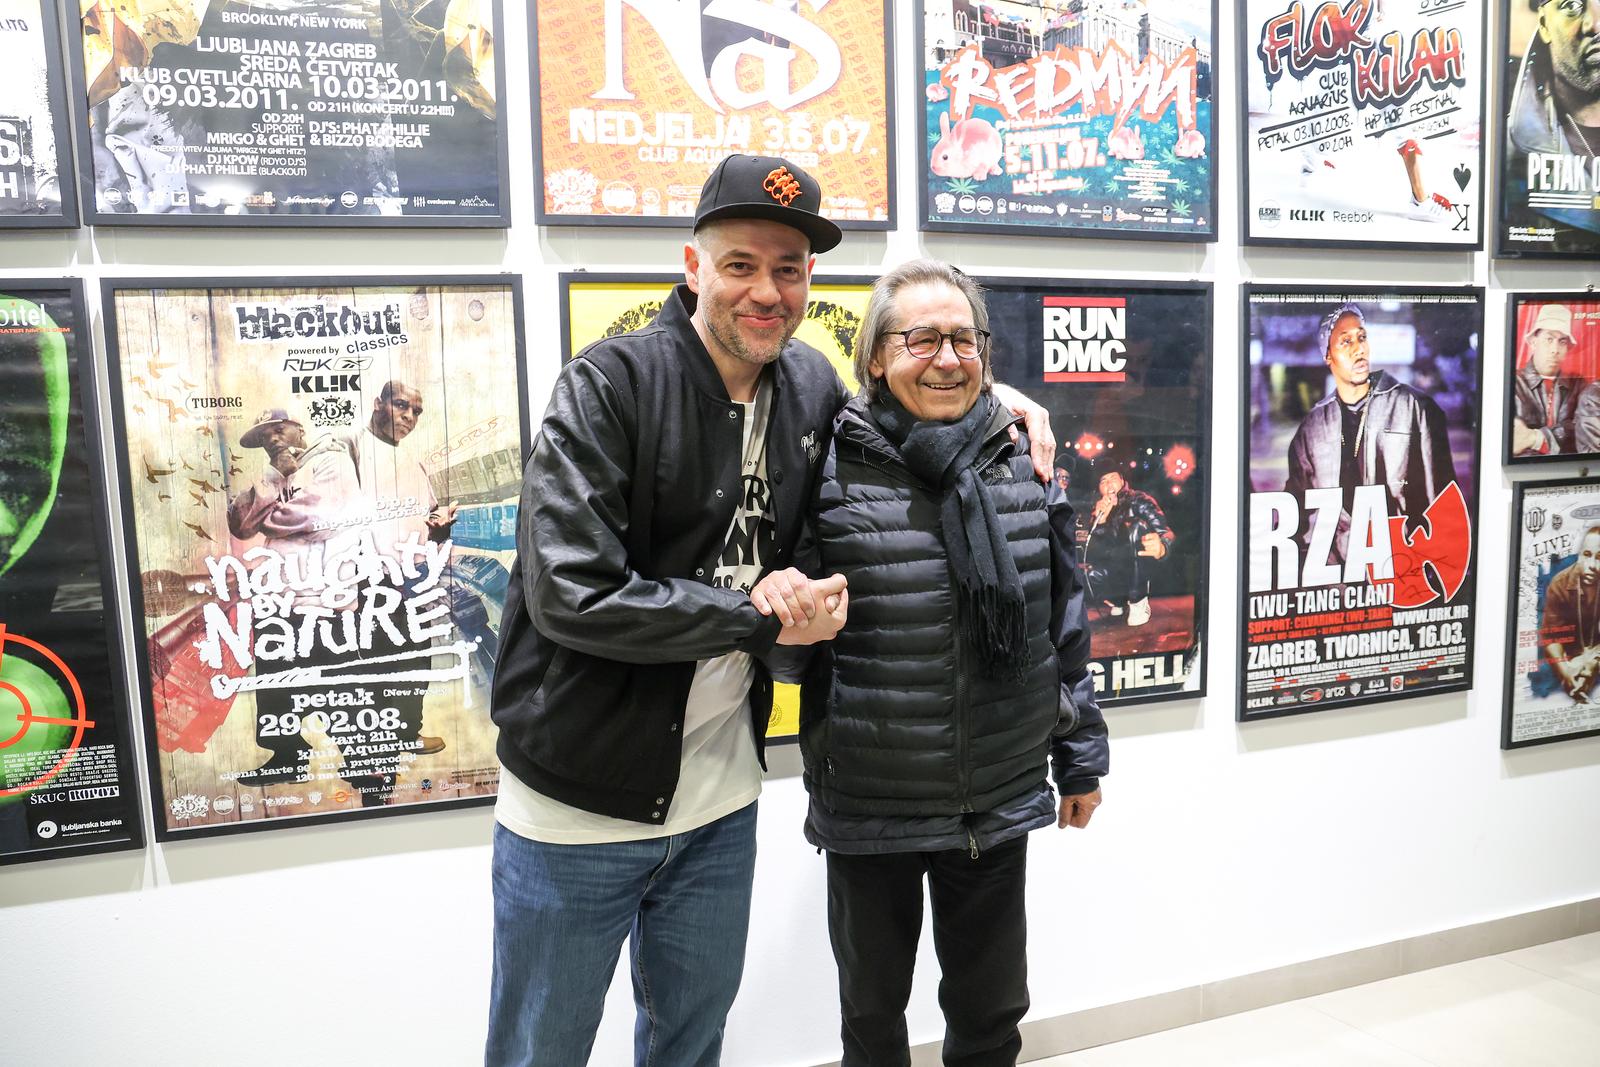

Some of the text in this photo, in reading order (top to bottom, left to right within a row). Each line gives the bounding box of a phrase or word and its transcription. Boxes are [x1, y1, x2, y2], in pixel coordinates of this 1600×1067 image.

[299, 15, 329, 29] NEW
[332, 17, 367, 30] YORK
[196, 36, 377, 60] LJUBLJANA ZAGREB
[240, 54, 399, 79] SREDA ČETVRTAK
[119, 66, 171, 84] KLUB
[142, 84, 299, 111] 09.03.2011.
[307, 102, 326, 113] OD
[328, 102, 350, 114] 21H
[410, 105, 420, 116] U
[261, 113, 305, 124] OD 20H
[251, 123, 303, 134] SUPPORT:
[342, 122, 378, 136] PHAT
[206, 132, 305, 147] MRIGO & GHET
[309, 134, 321, 146] &
[322, 134, 363, 147] BIZZO
[207, 154, 222, 165] DJ
[223, 154, 259, 166] KPOW
[184, 164, 214, 176] PHAT
[1527, 152, 1588, 192] PETAK
[1332, 210, 1374, 223] Reebok
[1042, 307, 1126, 340] RUN
[287, 345, 340, 356] powered by
[346, 334, 408, 354] classics
[1043, 340, 1127, 373] DMC
[191, 396, 243, 409] TUBORG
[1249, 484, 1395, 593] RZA
[1532, 533, 1571, 557] LIVE
[1249, 583, 1395, 619] (WU-TANG CLAN)
[1247, 639, 1321, 671] ZAGREB,
[1323, 628, 1415, 661] TVORNICA,
[1417, 621, 1467, 649] 16.03.
[290, 687, 376, 713] petak
[258, 707, 408, 737] 29.02.08.
[369, 730, 398, 743] 21h
[342, 738, 425, 759] Aquarius
[260, 765, 294, 778] karte
[295, 773, 315, 783] 120
[337, 768, 372, 781] ulazu
[374, 763, 411, 777] kluba
[30, 791, 66, 805] ŠKUC
[99, 818, 123, 828] banka
